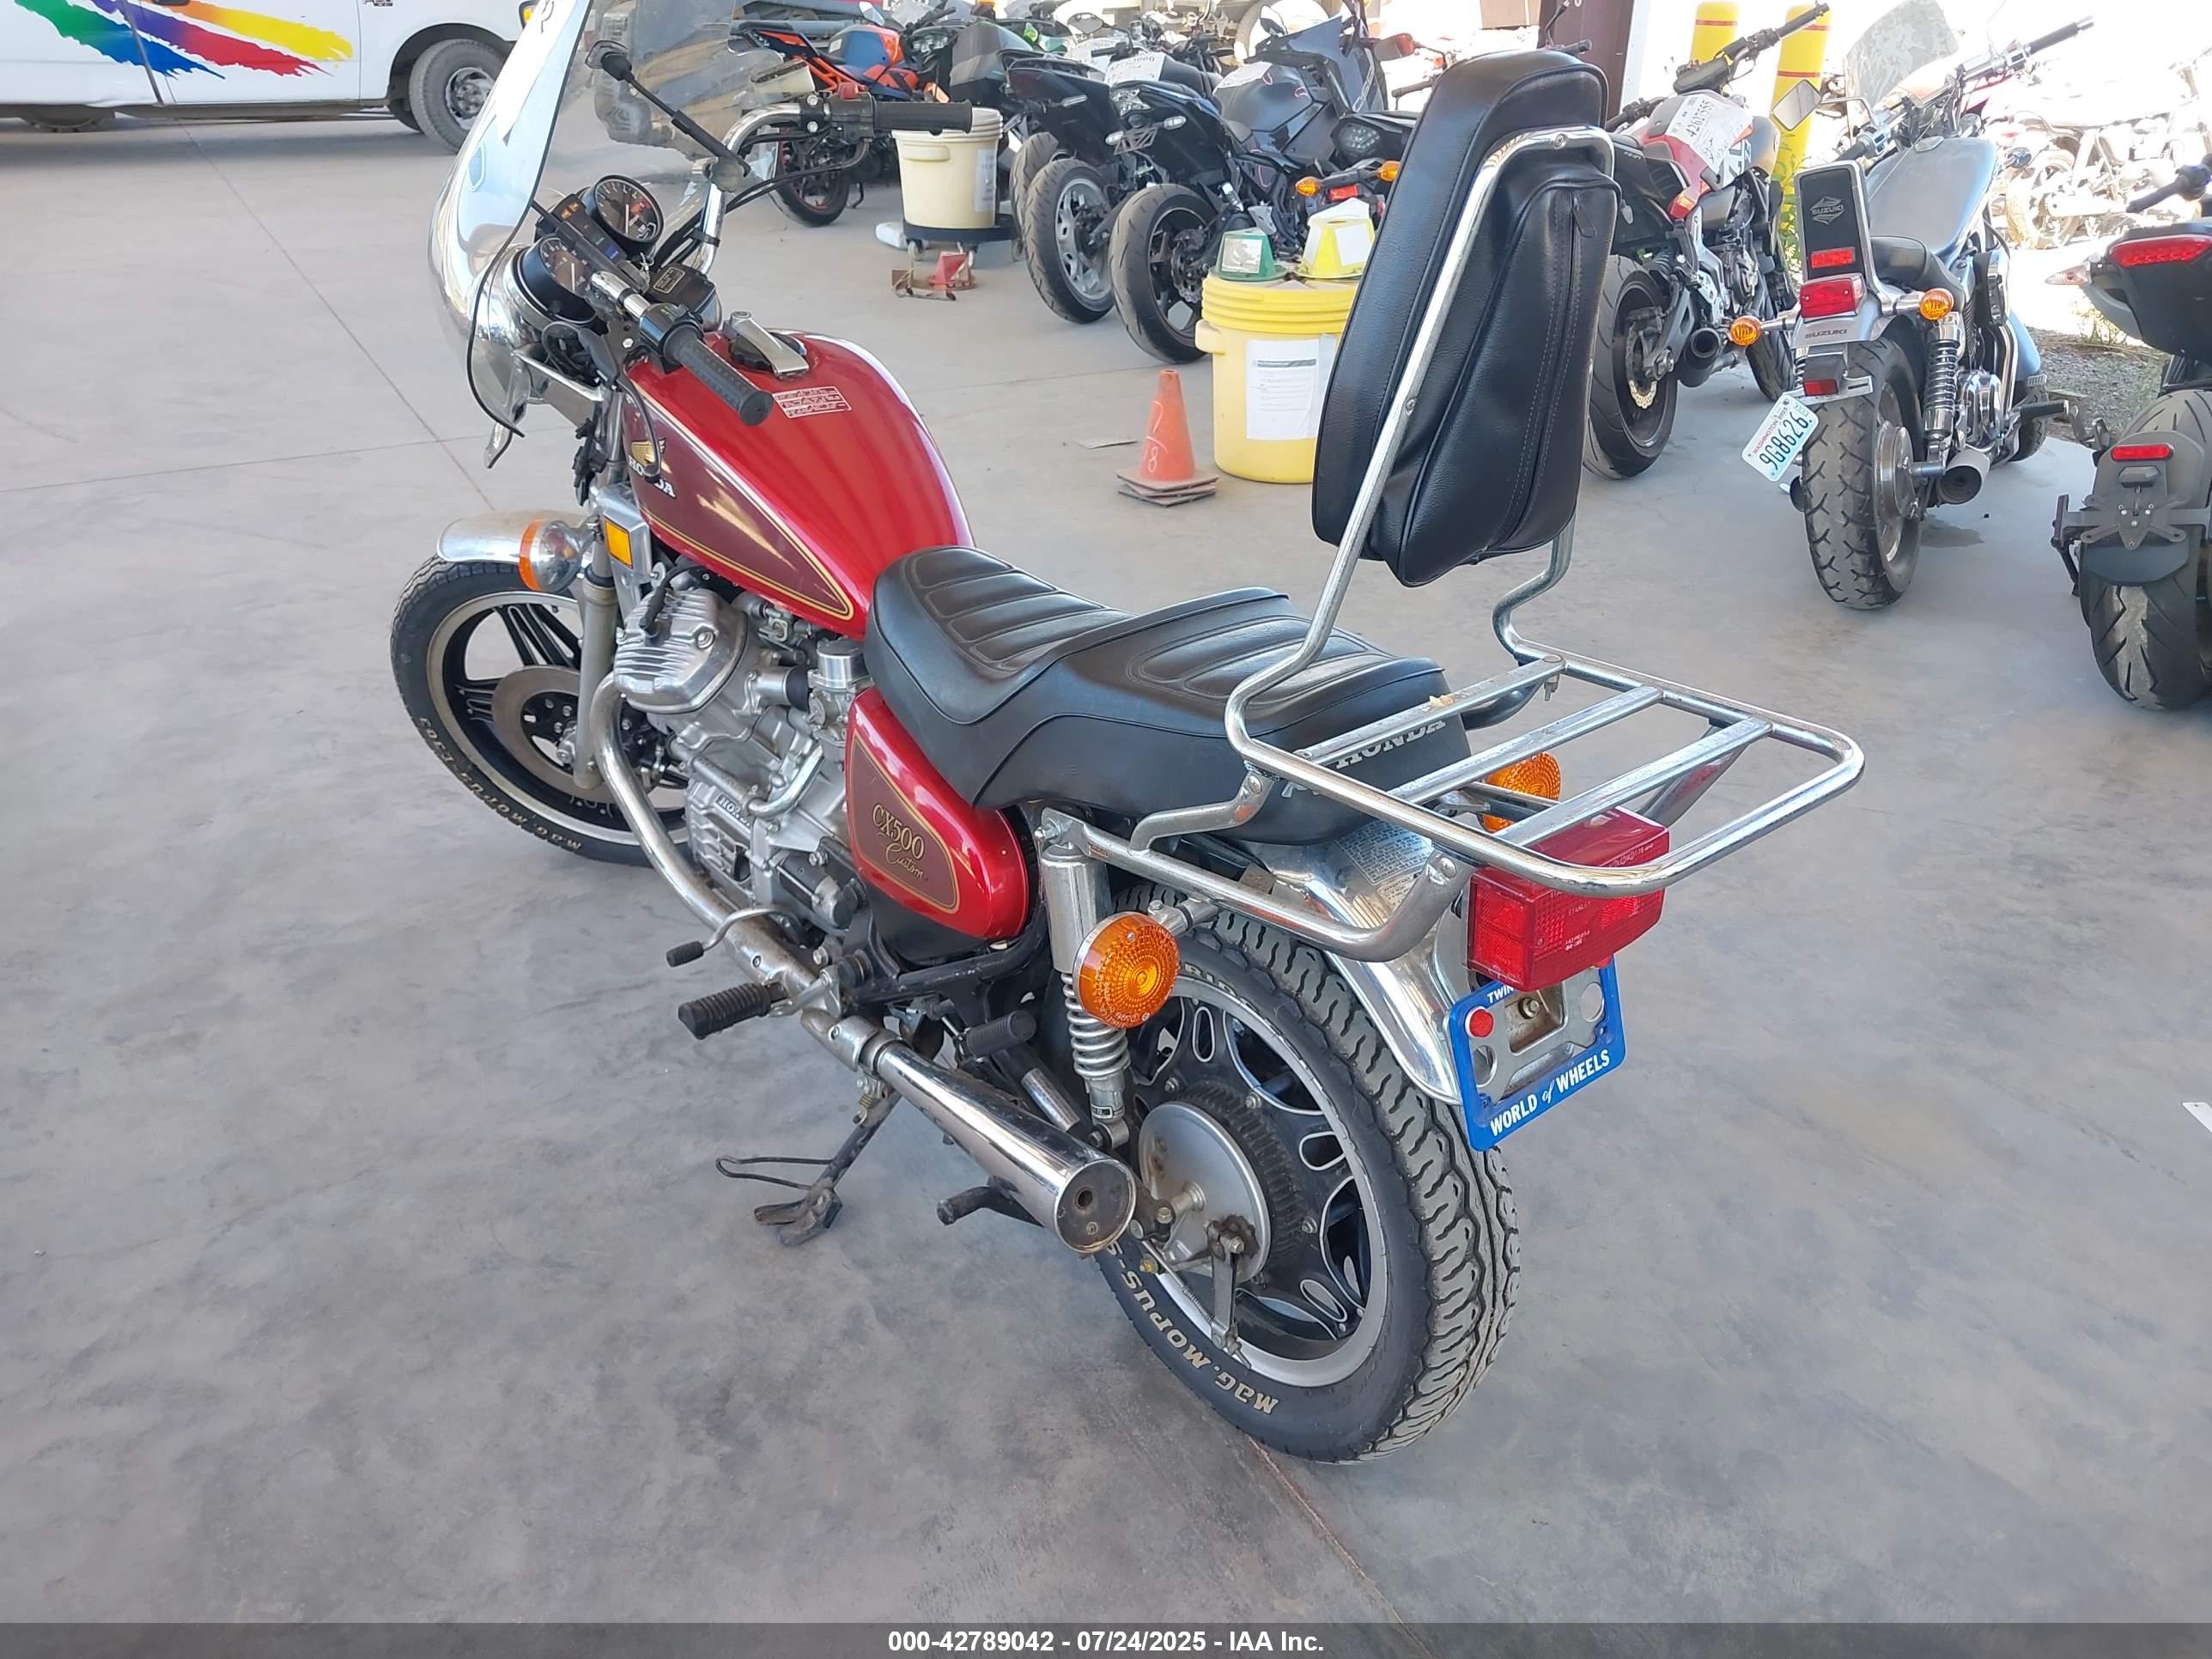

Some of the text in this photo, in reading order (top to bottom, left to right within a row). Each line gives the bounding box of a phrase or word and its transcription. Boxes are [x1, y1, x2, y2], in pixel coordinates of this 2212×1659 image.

[1812, 204, 1844, 216] SUZUKI
[1805, 329, 1847, 340] SUZUKI
[1752, 419, 1779, 454] WASHINGTON
[1759, 411, 1809, 471] 9G8626
[872, 804, 925, 860] CX500
[885, 842, 925, 879] Custom
[1490, 1049, 1610, 1136] WORLD of WHEELS
